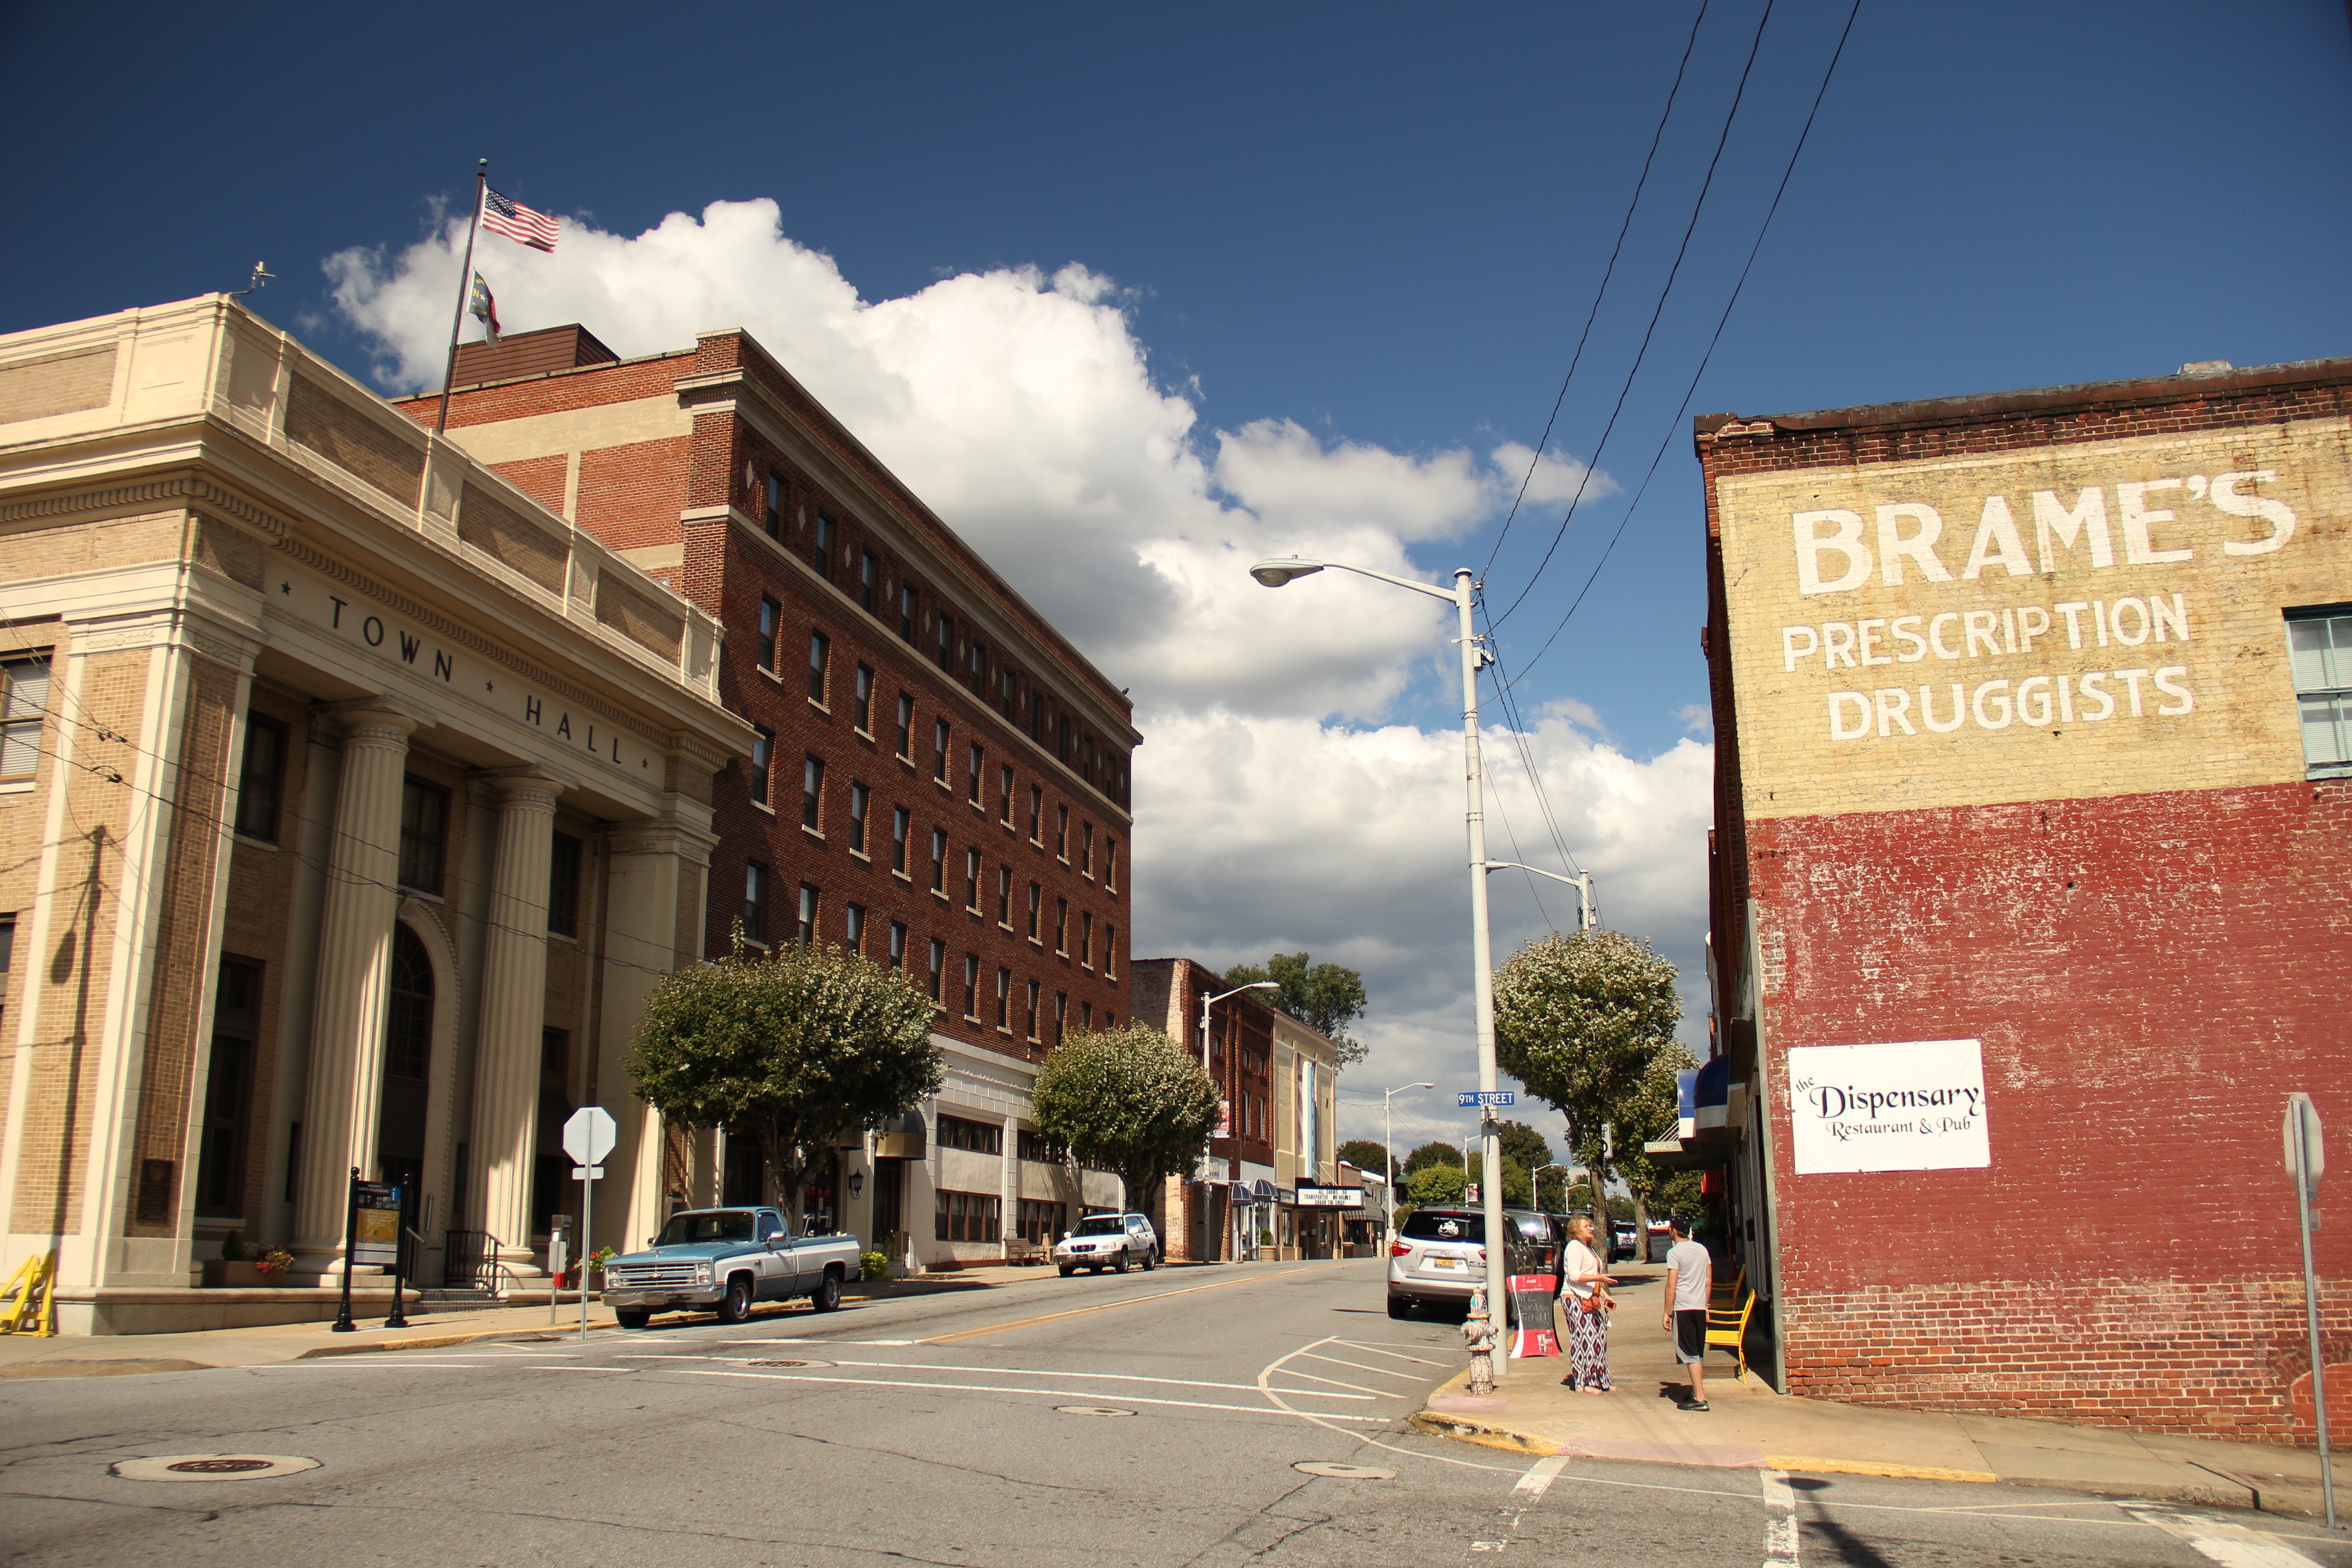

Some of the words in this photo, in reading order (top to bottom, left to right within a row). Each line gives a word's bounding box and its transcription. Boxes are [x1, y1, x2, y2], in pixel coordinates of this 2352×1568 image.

[1792, 470, 2297, 596] BRAME'S
[1782, 593, 2190, 672] PRESCRIPTION
[329, 595, 453, 683] TOWN
[525, 694, 622, 764] HALL
[1828, 665, 2195, 742] DRUGGISTS
[1795, 1076, 1816, 1093] the
[1459, 1094, 1474, 1104] 9TH
[1477, 1093, 1513, 1104] STREET
[1809, 1085, 1981, 1121] Dispensary
[1826, 1121, 1913, 1142] Restaurant
[1919, 1118, 1935, 1135] &
[1936, 1116, 1971, 1137] Pub
[1648, 1143, 1673, 1152] SHOES
[1517, 1292, 1535, 1303] NFL
[1519, 1303, 1549, 1316] Sunday
